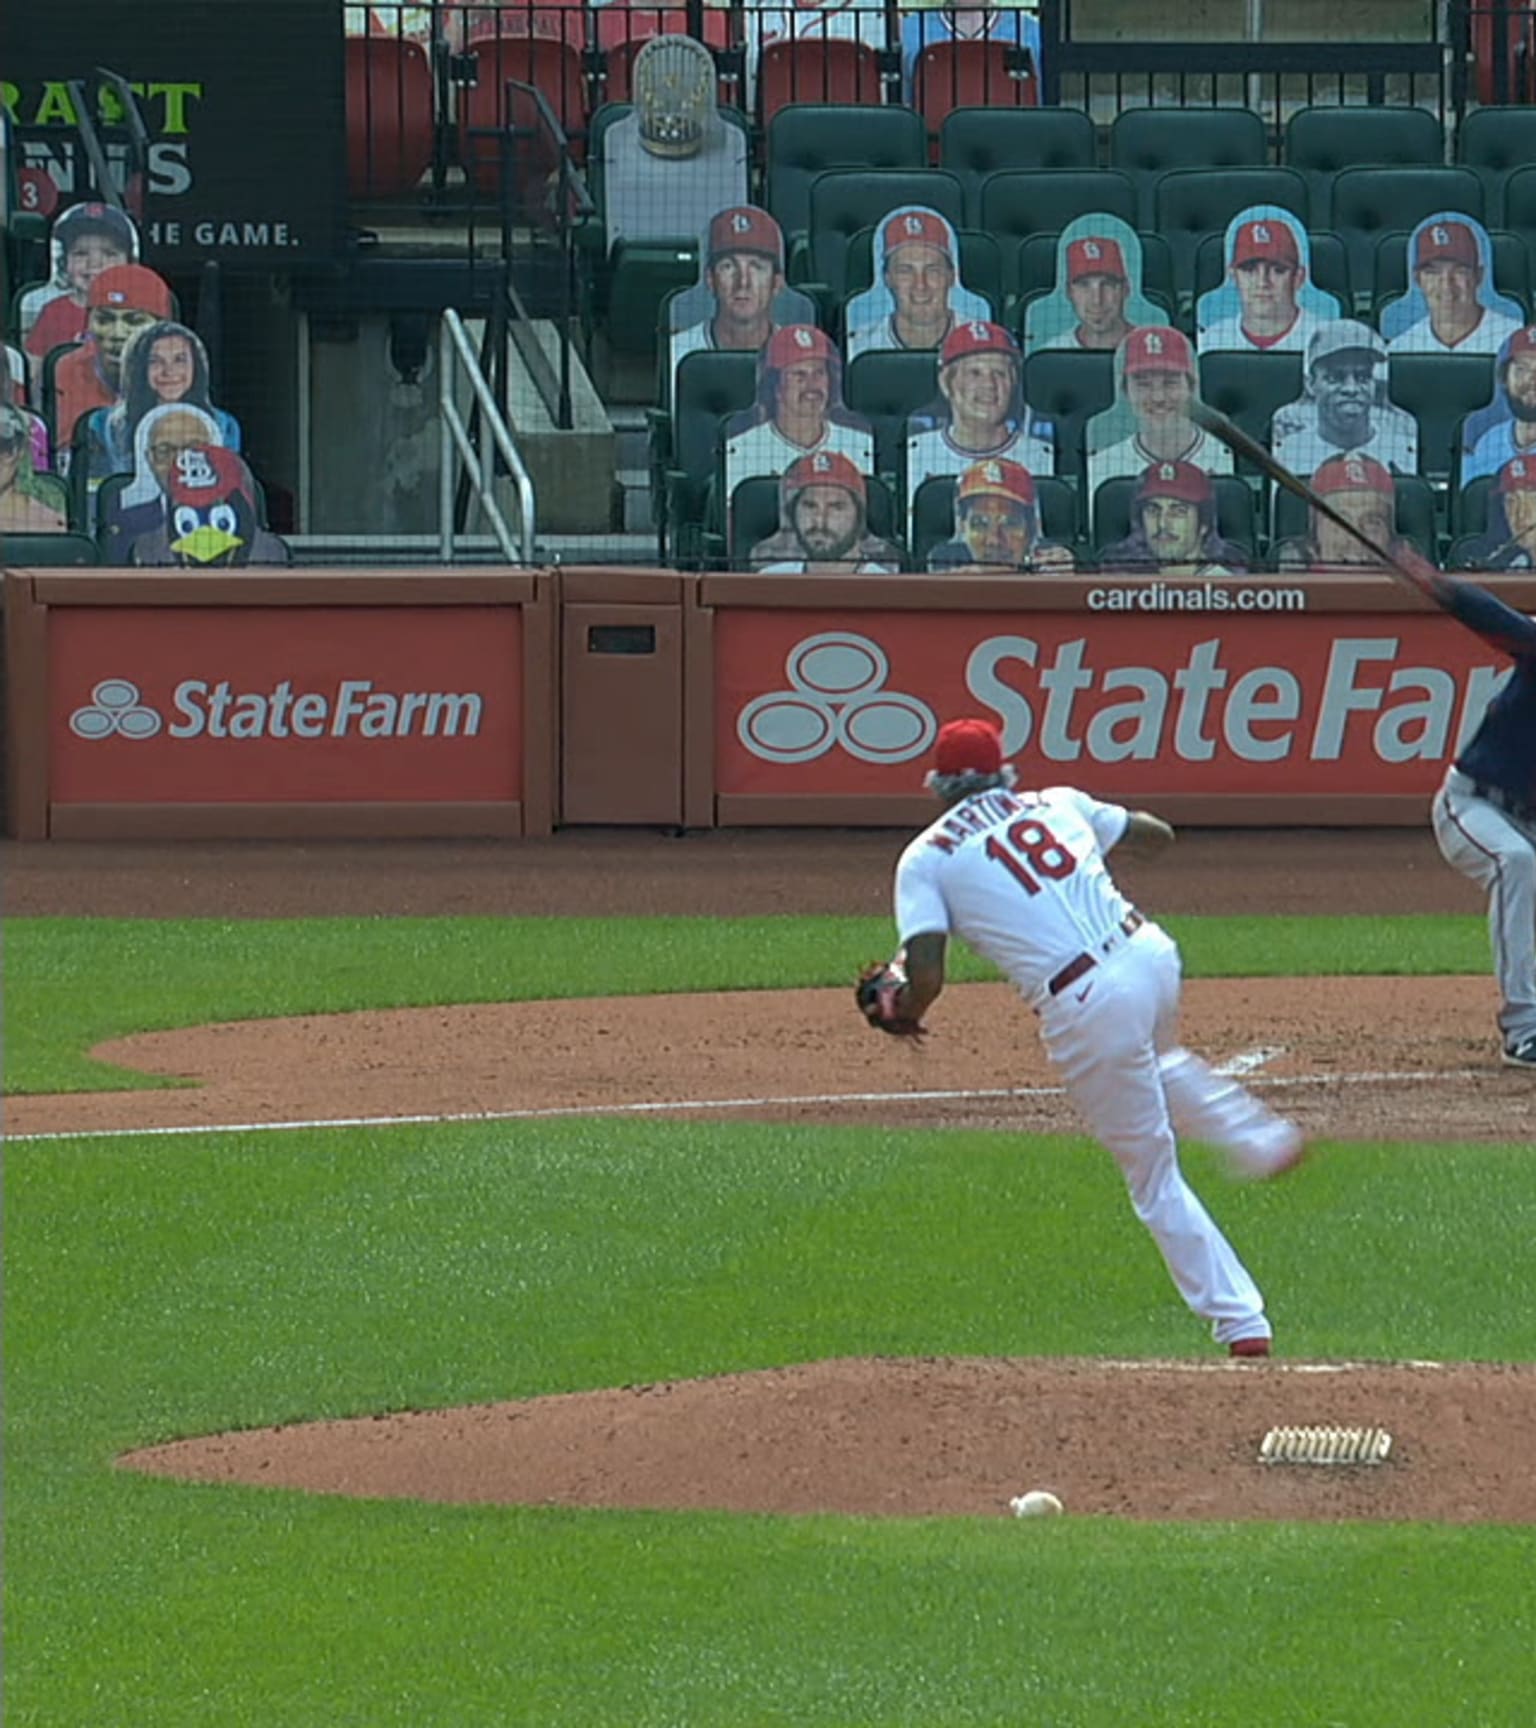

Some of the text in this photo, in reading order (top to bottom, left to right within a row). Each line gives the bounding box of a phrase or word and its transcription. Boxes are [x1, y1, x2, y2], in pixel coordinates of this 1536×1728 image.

[22, 182, 38, 208] 3
[194, 222, 300, 246] GAME.
[1086, 582, 1305, 611] cardinals.com
[985, 818, 1077, 897] 18
